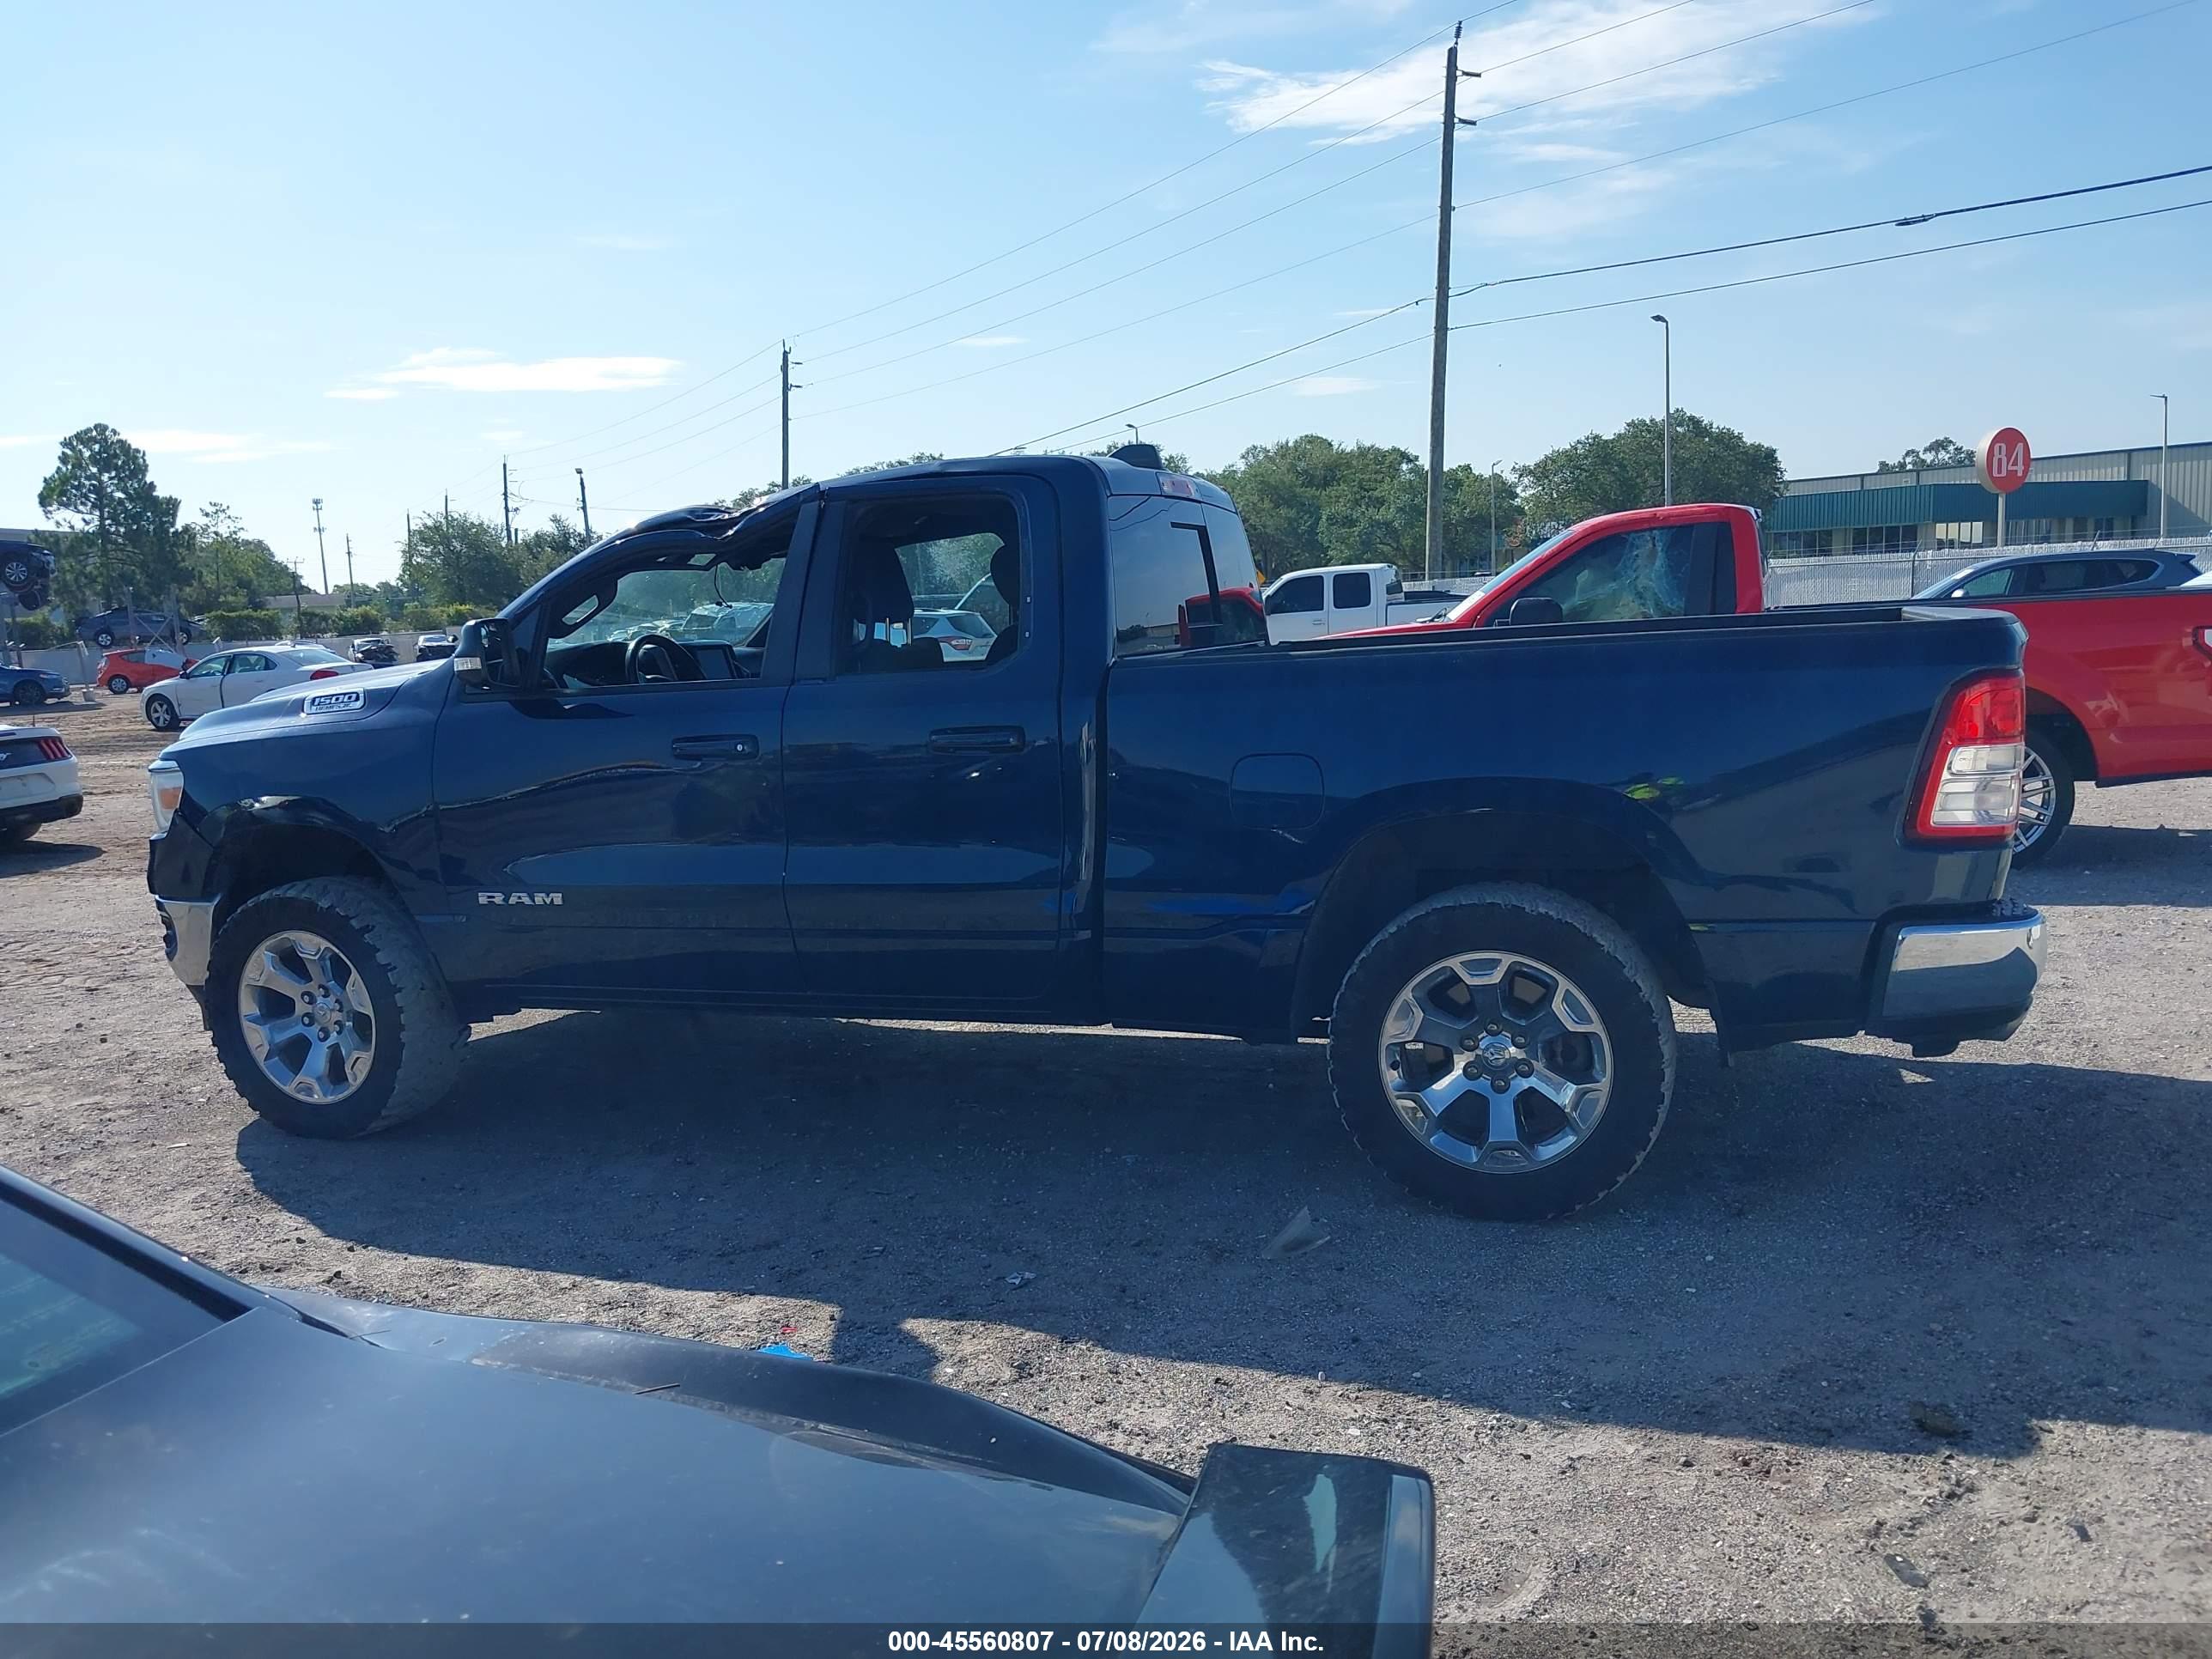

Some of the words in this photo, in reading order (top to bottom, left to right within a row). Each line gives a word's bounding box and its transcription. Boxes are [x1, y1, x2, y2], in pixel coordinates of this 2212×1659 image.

[1992, 442, 2024, 477] 84
[313, 693, 357, 706] 1500
[477, 892, 563, 905] RAM
